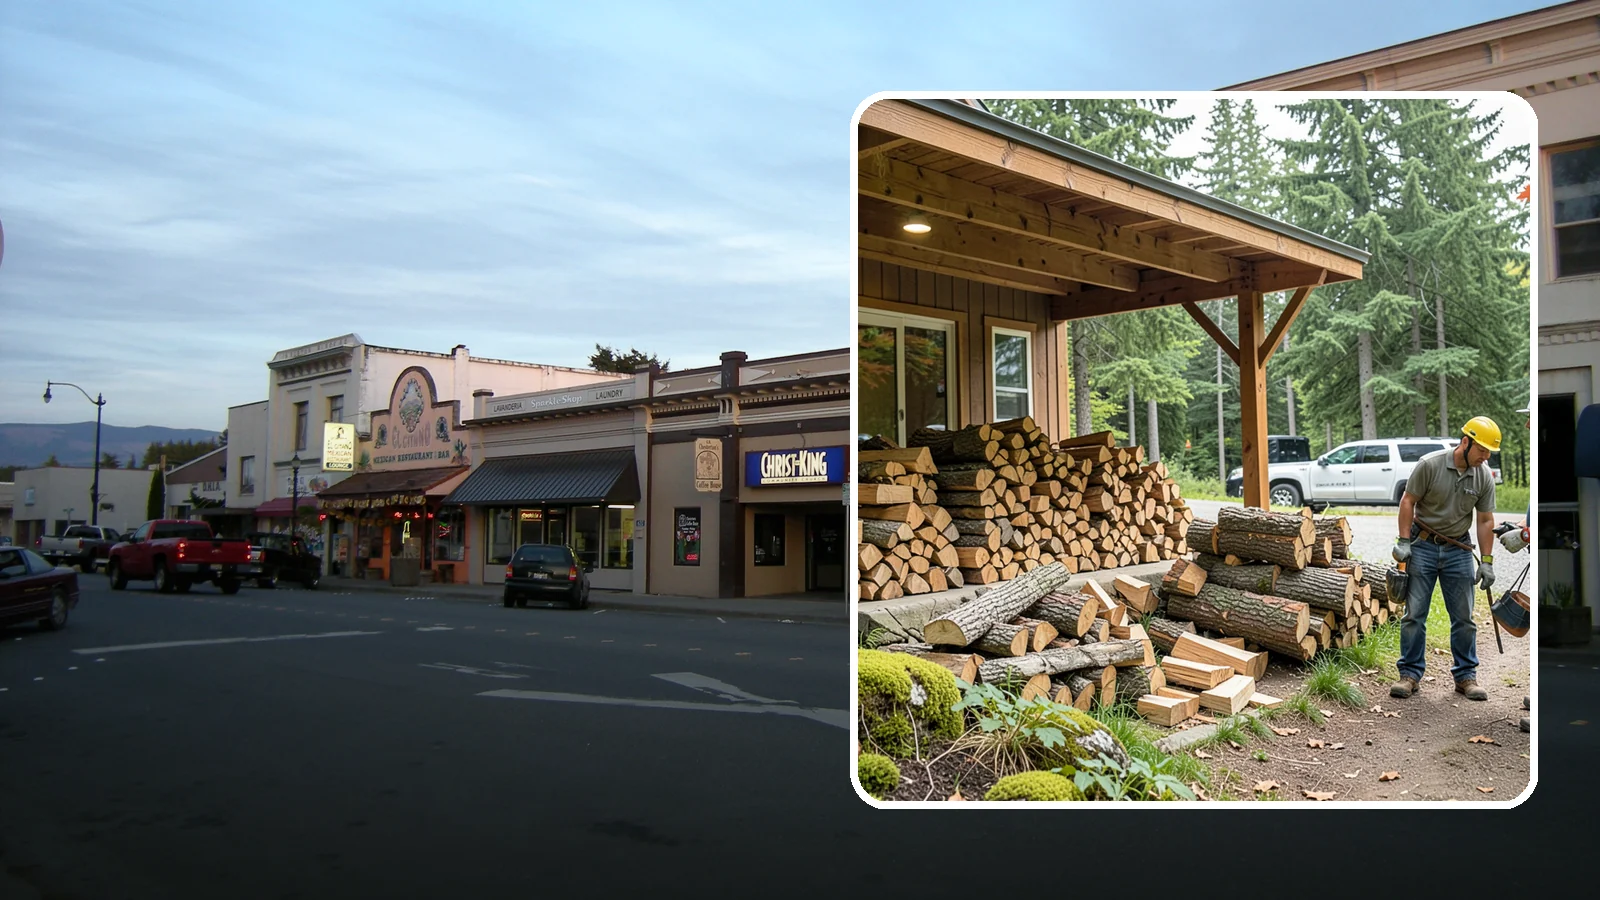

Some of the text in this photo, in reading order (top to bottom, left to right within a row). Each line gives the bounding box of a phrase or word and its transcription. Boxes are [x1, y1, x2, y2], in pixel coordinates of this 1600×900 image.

[531, 394, 582, 408] Sparkle Shop
[595, 389, 623, 400] LAUNDRY
[493, 402, 523, 413] LAVANDERIA
[374, 456, 396, 464] MEXICAN
[398, 452, 433, 462] RESTAURANT
[438, 450, 450, 459] BAR
[761, 450, 827, 478] CHRIST KING
